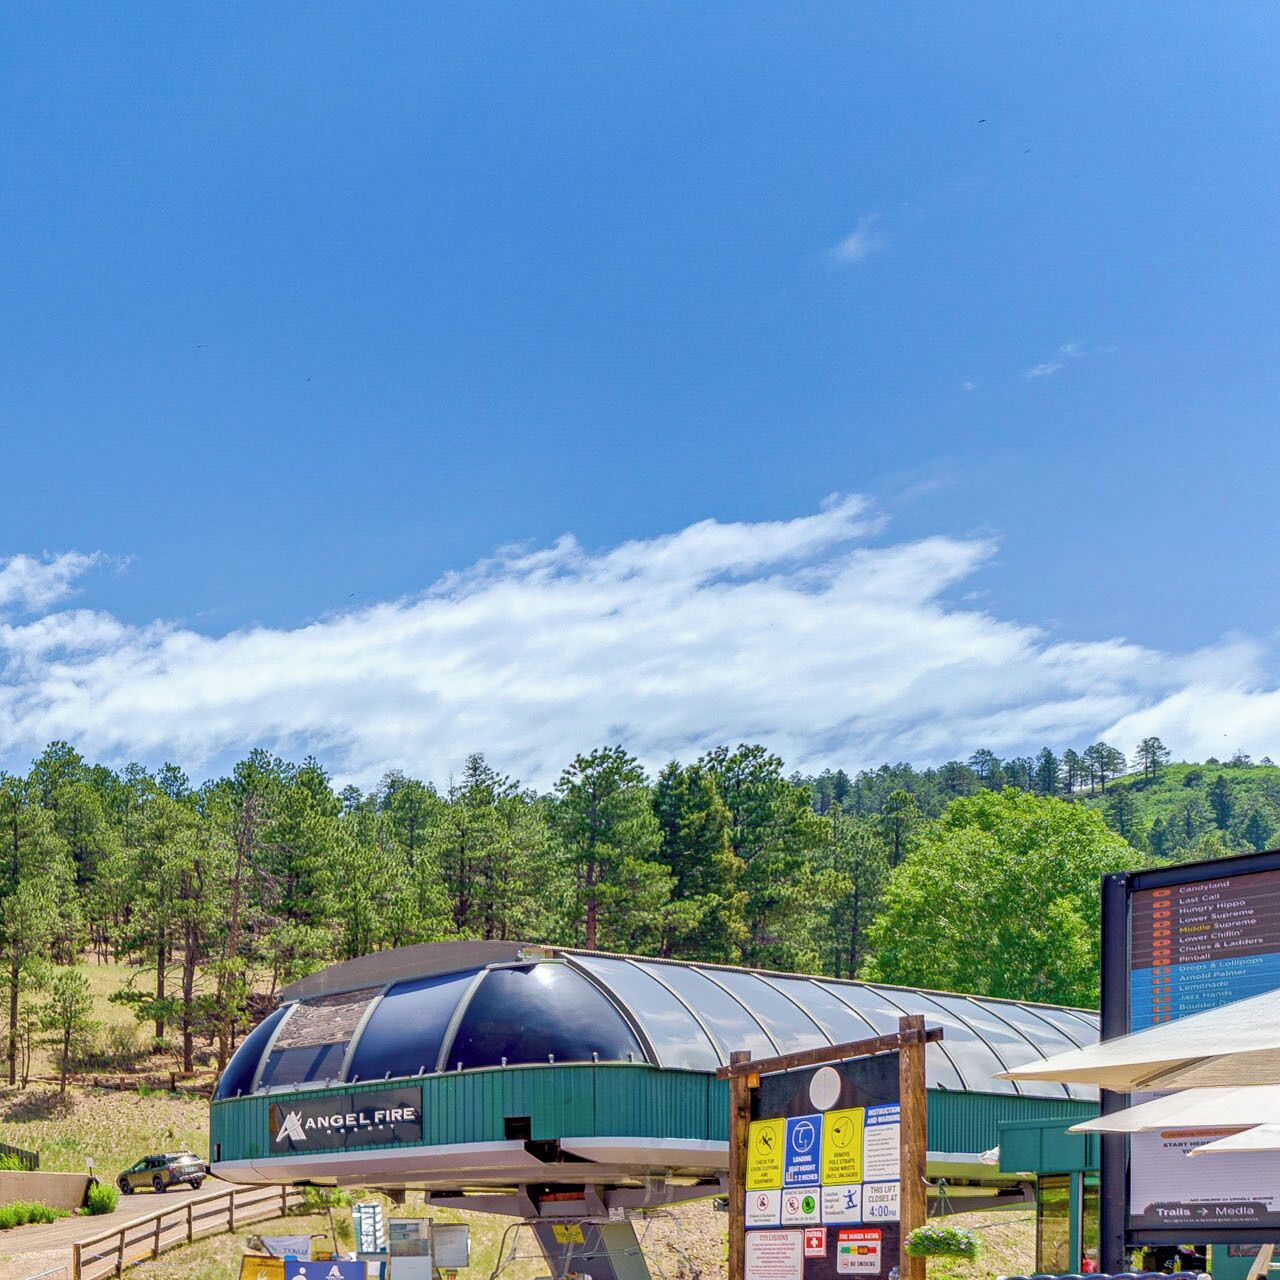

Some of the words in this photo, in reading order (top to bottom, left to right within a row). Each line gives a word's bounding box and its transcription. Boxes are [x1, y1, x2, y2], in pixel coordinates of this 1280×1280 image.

[1179, 880, 1230, 894] Candyland
[1179, 895, 1199, 905] Last
[1201, 893, 1220, 902] Call
[1179, 903, 1214, 914] Hungry
[1216, 900, 1246, 911] Hippo
[1179, 915, 1208, 924] Lower
[1211, 909, 1254, 920] Supreme
[1179, 924, 1211, 934] Middle
[1214, 919, 1257, 929] Supreme
[1179, 934, 1208, 943] Lower
[1211, 929, 1243, 939] Chillin'
[1179, 944, 1211, 953] Chutes
[1224, 938, 1263, 947] Ladders
[1179, 953, 1211, 962] Pinball
[1179, 963, 1207, 973] Drops
[1219, 957, 1264, 968] Lollipops
[1179, 972, 1211, 982] Arnold
[1214, 969, 1246, 978] Palmer
[1179, 981, 1228, 992] Lemonade
[1179, 992, 1200, 1001] Jazz
[1202, 990, 1232, 998] Hands
[1179, 1001, 1216, 1011] Boulder
[305, 1113, 371, 1129] ANGEL
[374, 1107, 415, 1123] FIRE
[871, 1186, 883, 1194] THIS
[884, 1185, 896, 1193] LIFT
[868, 1195, 889, 1203] CLOSES
[1157, 1208, 1191, 1217] Trails
[1215, 1206, 1254, 1216] Media
